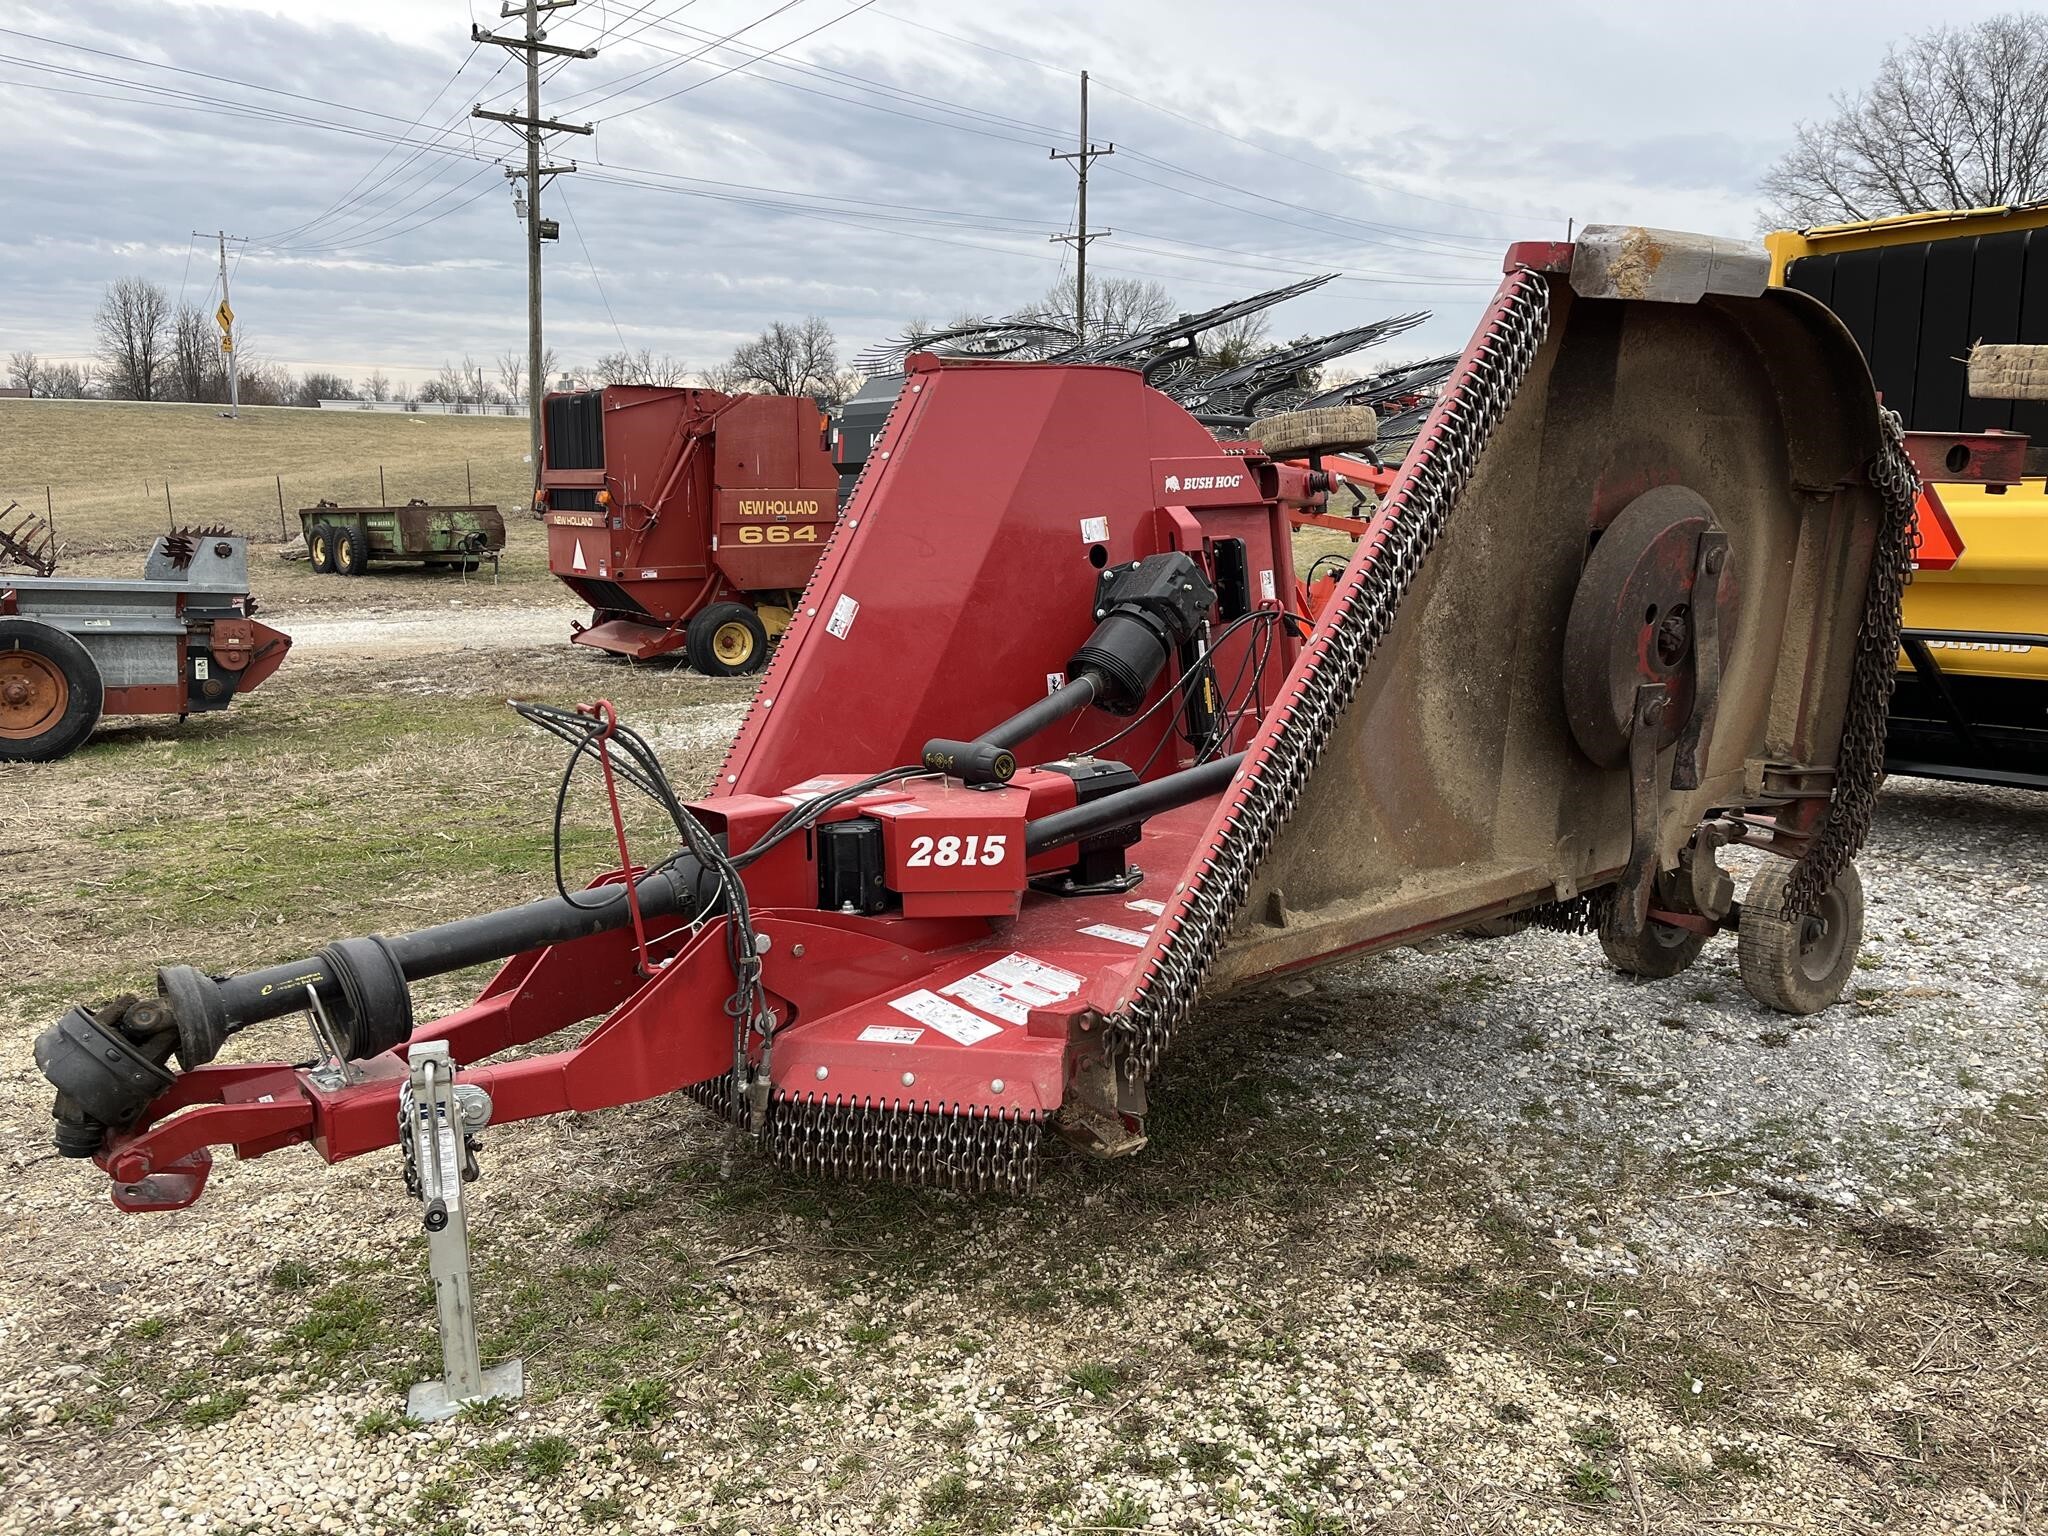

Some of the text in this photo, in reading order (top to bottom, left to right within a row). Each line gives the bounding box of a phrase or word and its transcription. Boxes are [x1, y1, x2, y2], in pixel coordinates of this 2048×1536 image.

[1183, 474, 1240, 490] BUSH HOG
[739, 500, 819, 515] NEW HOLLAND
[553, 515, 593, 527] NEW HOLLAND
[739, 525, 818, 544] 664
[906, 835, 1007, 867] 2815
